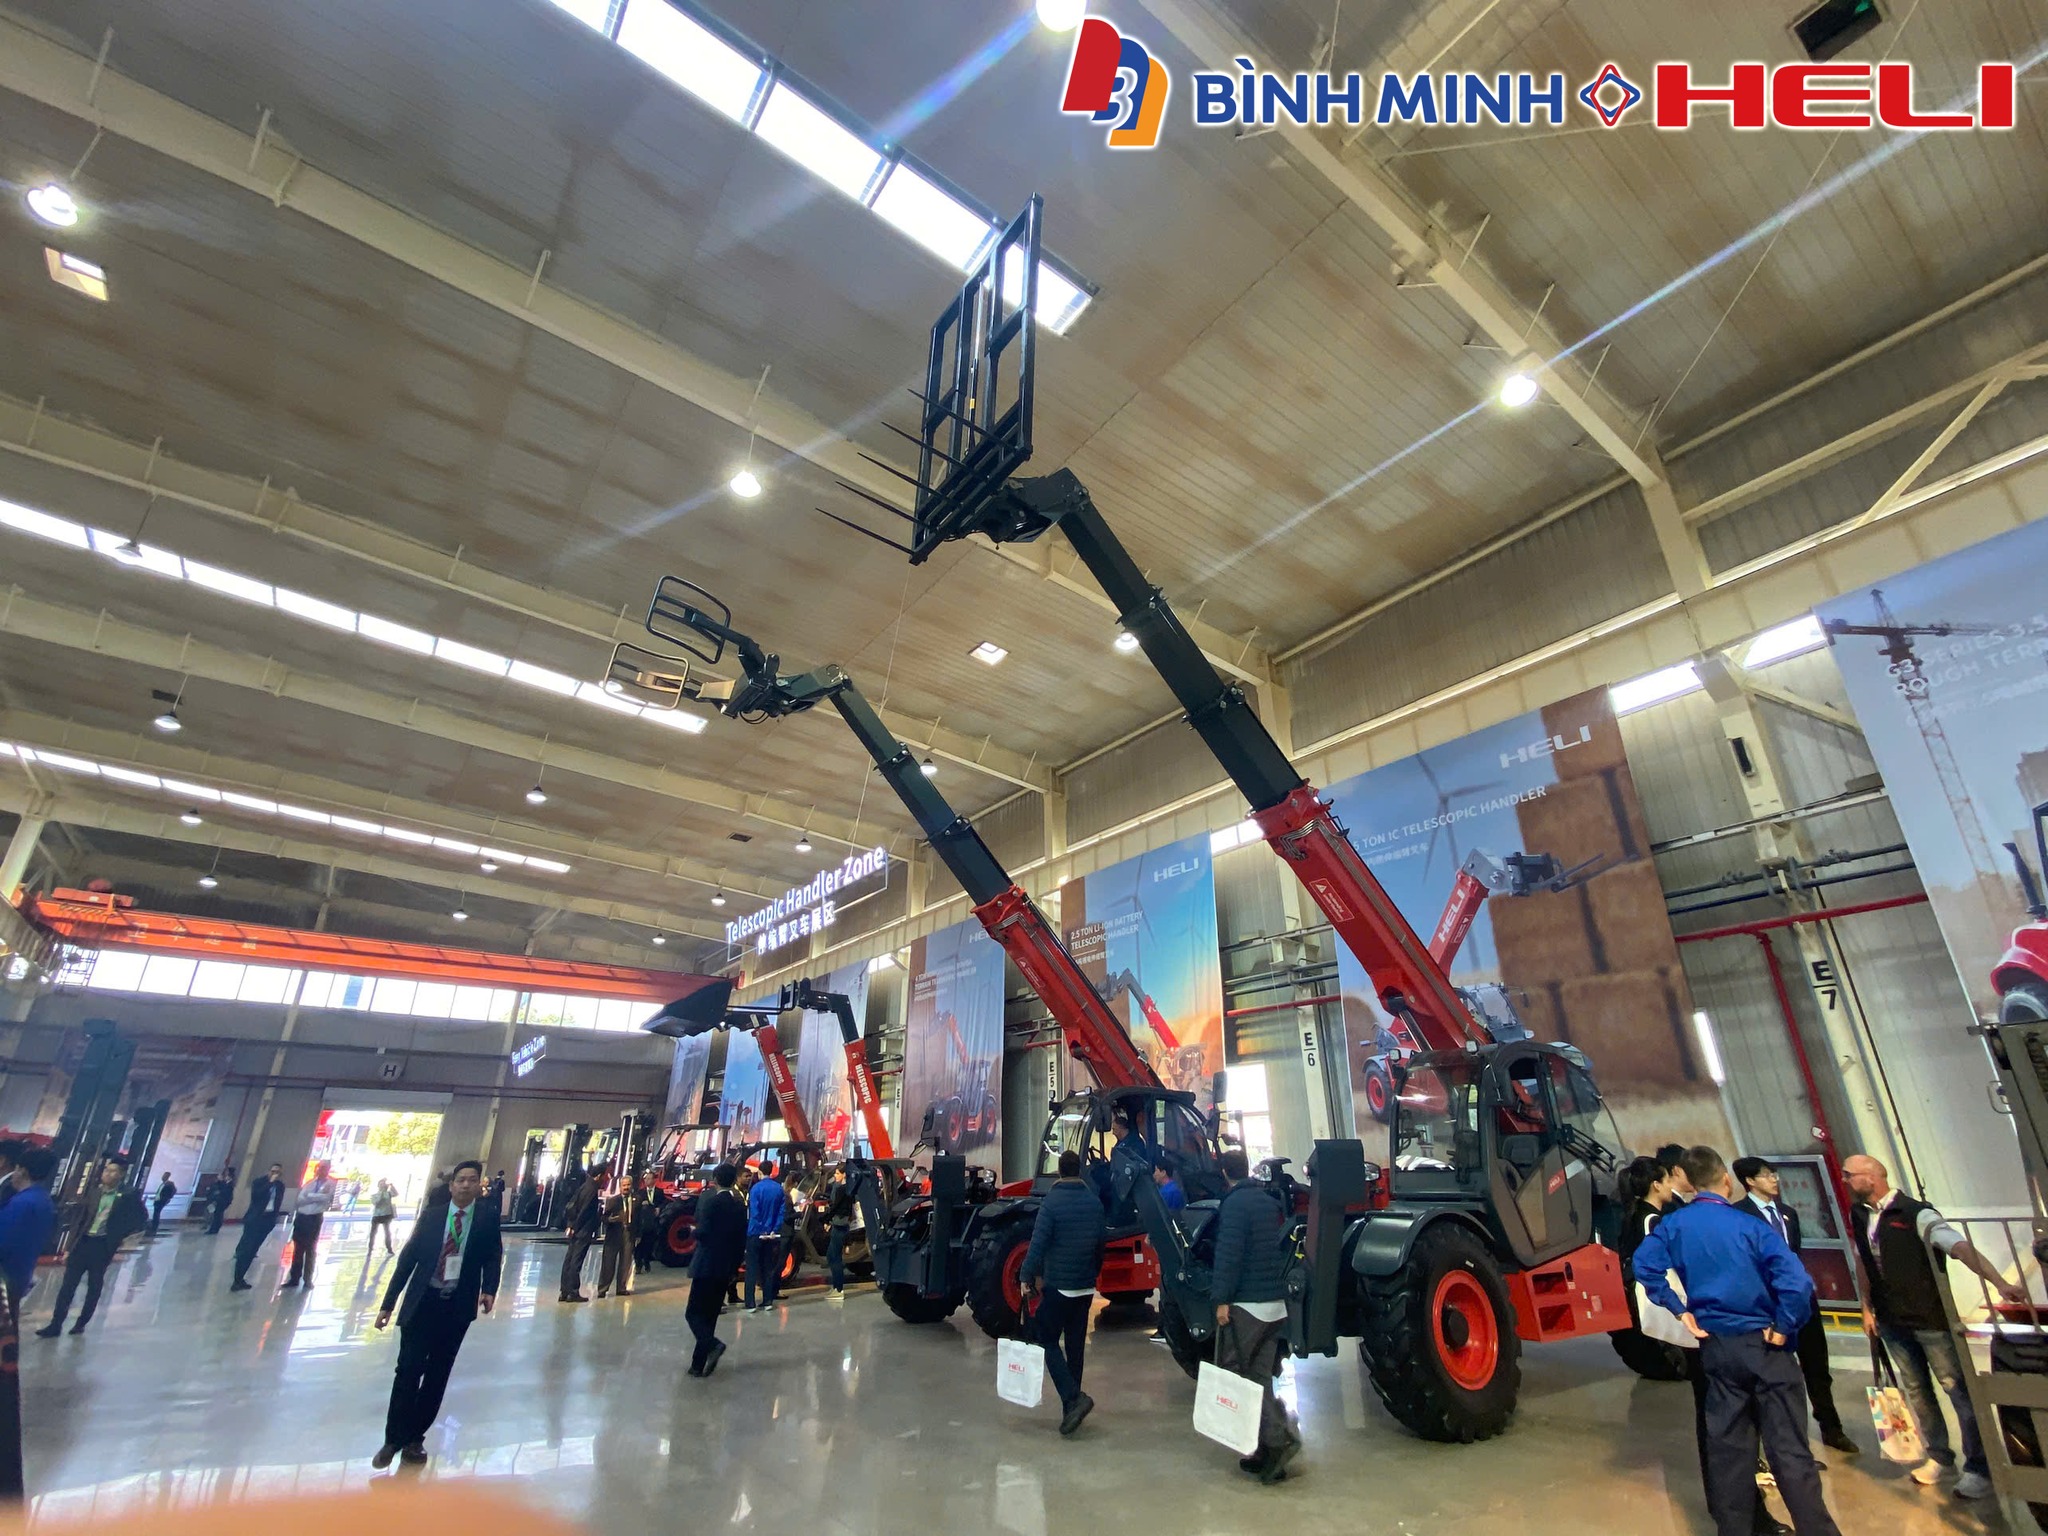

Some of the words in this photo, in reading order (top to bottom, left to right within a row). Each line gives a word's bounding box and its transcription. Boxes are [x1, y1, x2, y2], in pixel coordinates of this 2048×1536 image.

[1920, 629, 2006, 668] SERIES
[1499, 724, 1592, 769] HELI
[1362, 833, 1386, 849] TON
[1388, 828, 1401, 841] IC
[1402, 804, 1478, 838] TELESCOPIC
[1480, 784, 1548, 815] HANDLER
[1153, 857, 1200, 883] HELI
[725, 897, 785, 944] Telescopic
[785, 869, 842, 915] Handler
[842, 845, 886, 886] Zone
[1438, 888, 1466, 943] HELI
[1071, 932, 1107, 951] TELESCOPIC
[1081, 925, 1094, 936] TON
[1811, 959, 1834, 982] E
[1820, 988, 1837, 1011] 7
[1303, 1032, 1314, 1047] E
[383, 1064, 398, 1078] H
[1049, 1061, 1055, 1073] E
[1307, 1052, 1316, 1067] 6
[854, 1063, 873, 1105] HELISCOPIC
[1008, 1362, 1025, 1373] HELI
